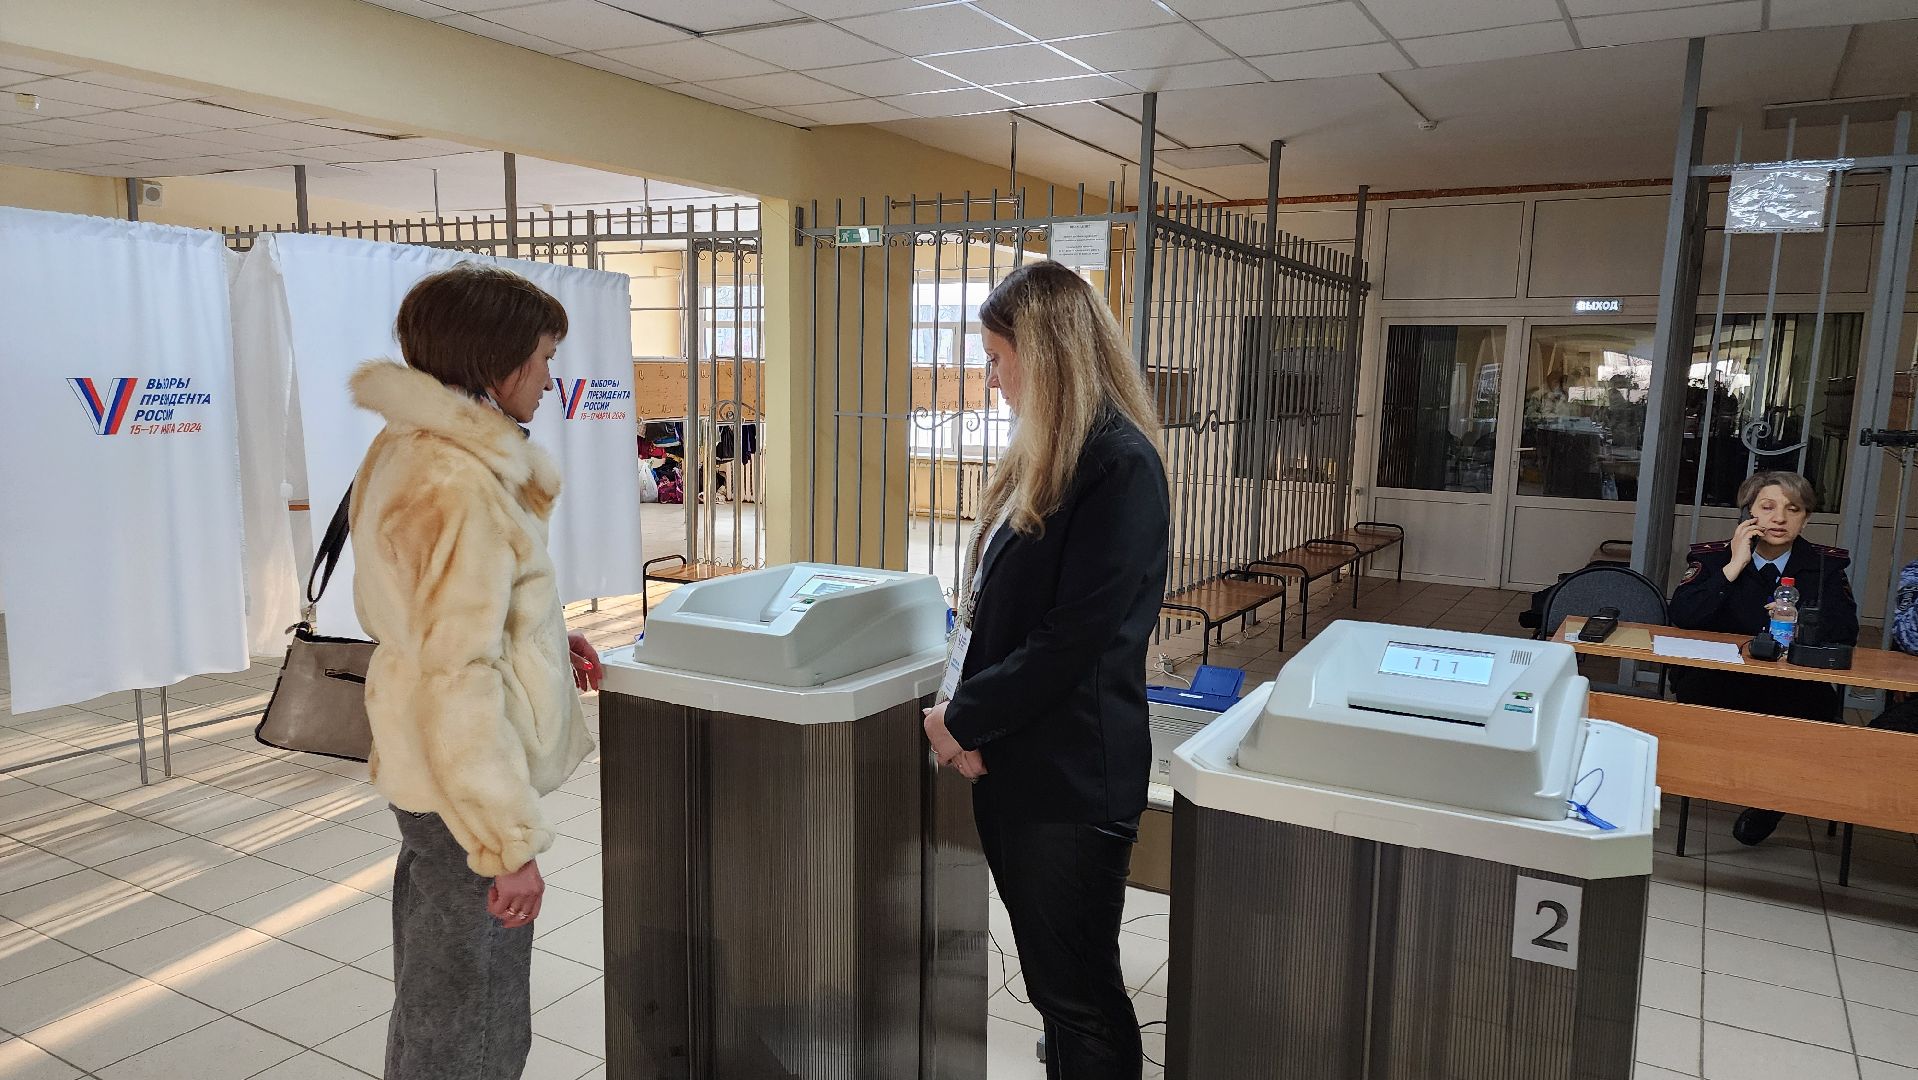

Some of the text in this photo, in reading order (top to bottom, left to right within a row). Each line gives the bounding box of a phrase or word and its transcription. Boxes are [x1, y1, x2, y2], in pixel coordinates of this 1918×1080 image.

[1576, 300, 1619, 311] ВЫХОД
[590, 379, 620, 388] ВЫБОРЫ
[586, 390, 631, 401] ПРЕЗИДЕНТА
[582, 401, 611, 411] РОССИИ
[176, 422, 202, 433] 2024
[1530, 900, 1569, 952] 2
